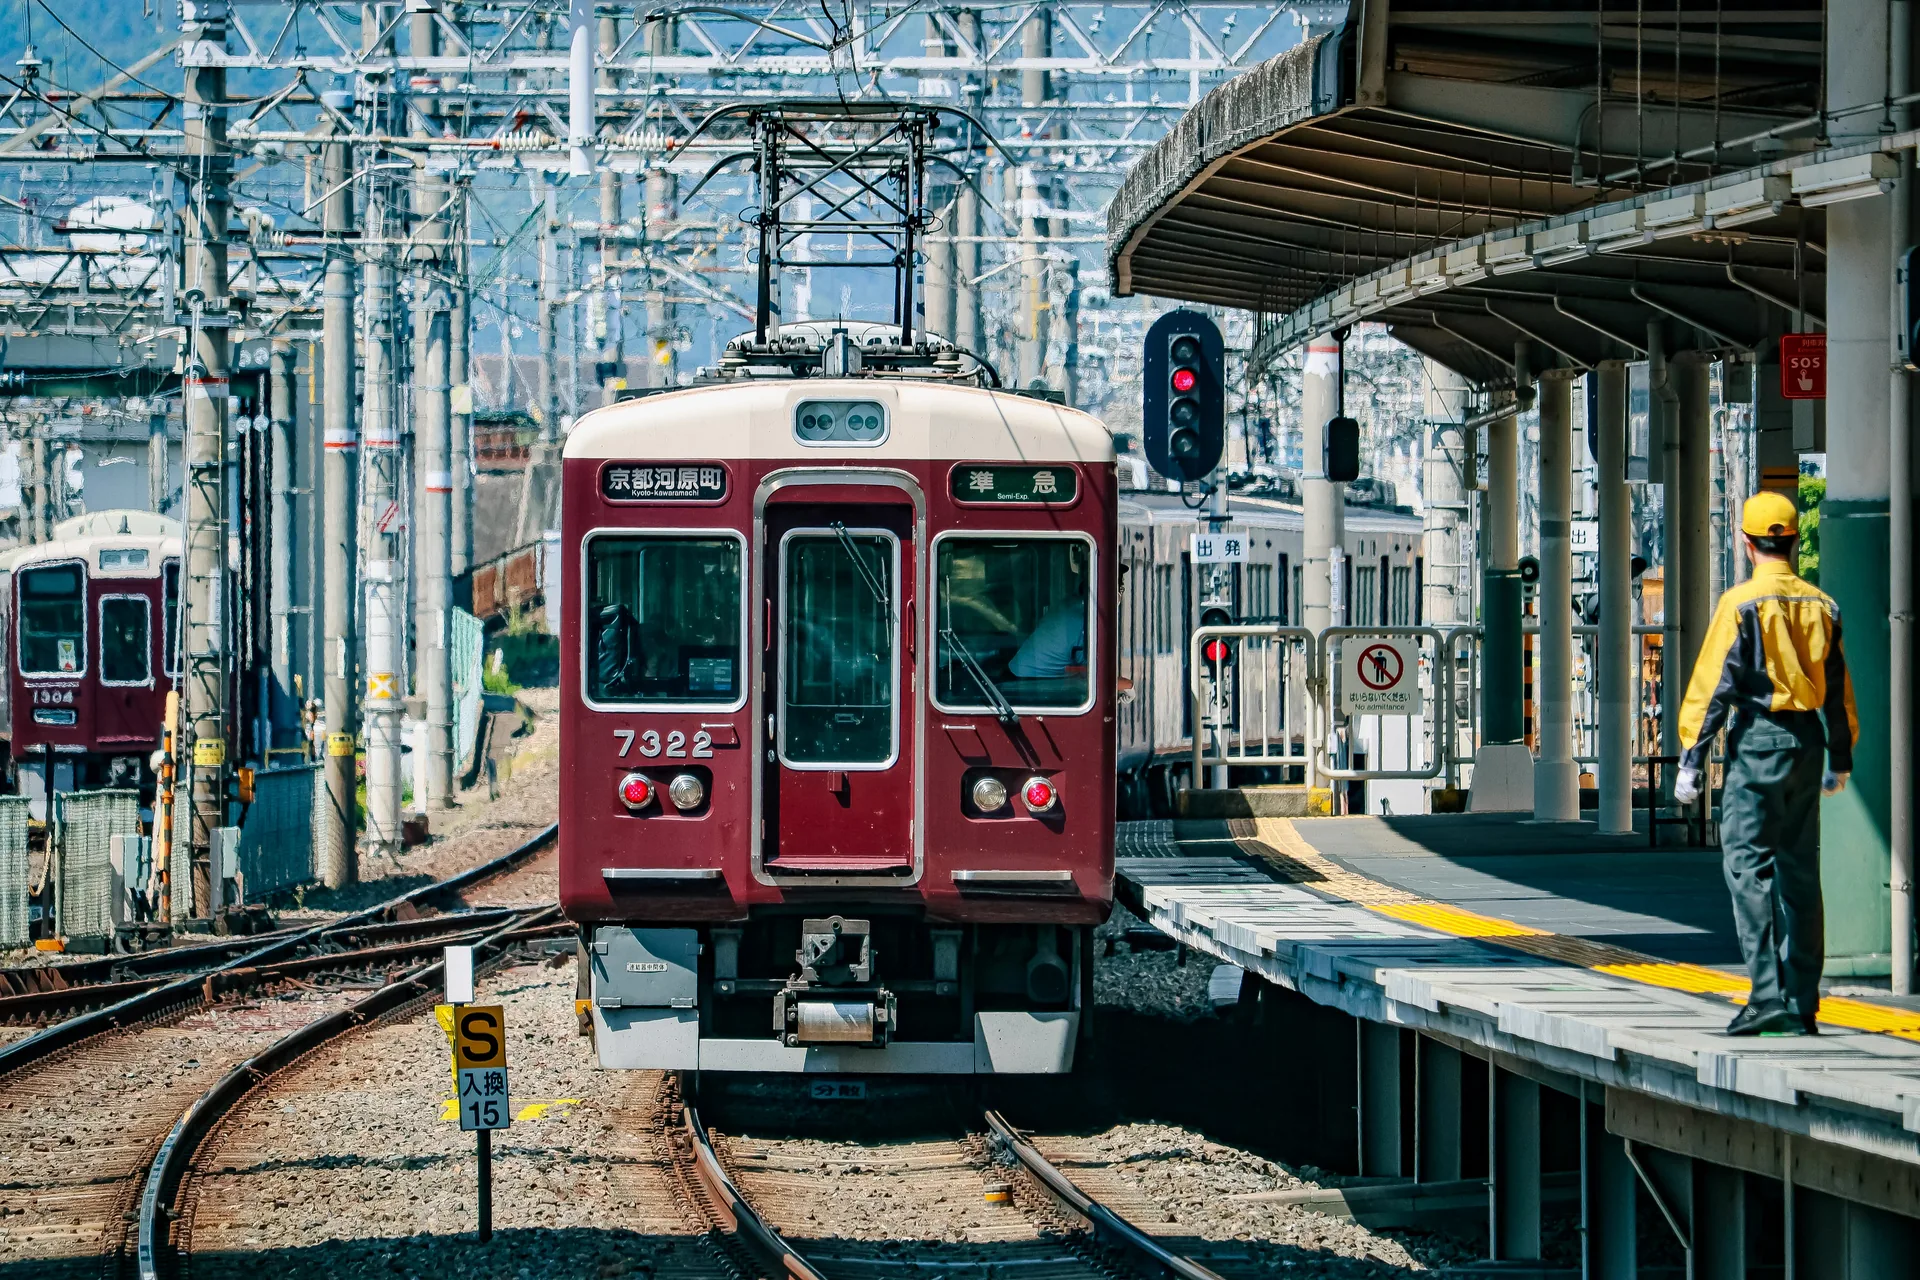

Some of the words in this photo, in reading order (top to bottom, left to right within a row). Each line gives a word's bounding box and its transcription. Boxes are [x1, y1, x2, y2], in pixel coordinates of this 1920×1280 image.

[1790, 357, 1821, 369] SOS
[608, 467, 722, 490] 京都河原町
[969, 471, 1058, 494] 準急
[631, 489, 700, 498] Kyoto-kawaramachi
[1197, 539, 1241, 557] 出発
[1349, 692, 1411, 702] はいらないでください
[1354, 703, 1366, 711] No
[1366, 703, 1405, 711] admittance
[613, 729, 713, 758] 7322
[460, 1012, 499, 1062] S
[462, 1071, 505, 1097] 入換
[468, 1100, 500, 1127] 15
